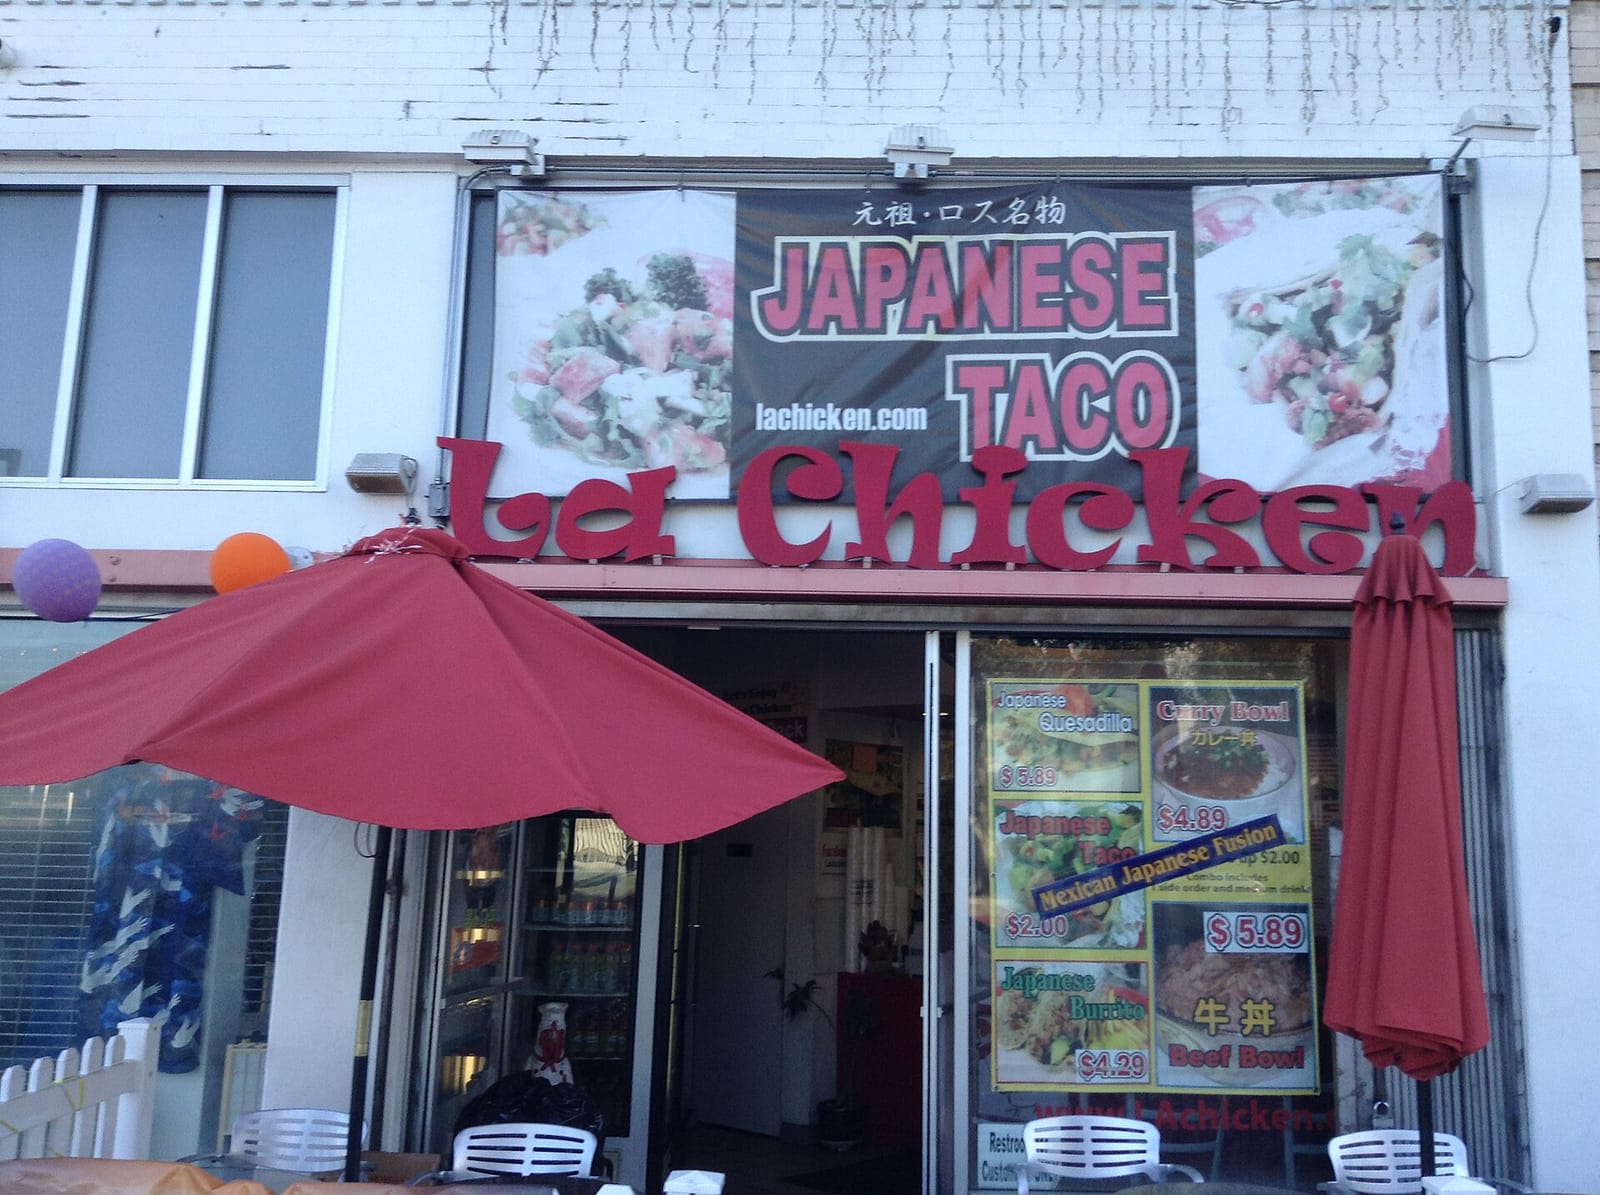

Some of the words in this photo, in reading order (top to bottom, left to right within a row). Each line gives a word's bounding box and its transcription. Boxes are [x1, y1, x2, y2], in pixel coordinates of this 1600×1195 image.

[755, 235, 1174, 338] JAPANESE
[756, 403, 927, 431] lachicken.com
[950, 355, 1177, 457] TACO
[436, 437, 676, 562] La
[737, 440, 1476, 577] Chicken
[997, 691, 1066, 711] Japanese
[1157, 701, 1226, 726] Curry
[1231, 700, 1290, 723] Bowl
[1039, 712, 1132, 733] Quesadilla
[999, 811, 1112, 840] Japanese
[1157, 804, 1228, 832] $4.89
[1078, 840, 1138, 865] Taco
[1261, 851, 1300, 865] $2.00
[1039, 874, 1117, 911] Mexican
[1121, 845, 1210, 885] Japanese
[1213, 824, 1277, 857] Fusion
[1183, 884, 1211, 892] order
[1214, 885, 1233, 893] and
[1006, 912, 1068, 938] $2.00
[1001, 967, 1096, 993] Japanese
[1070, 996, 1145, 1021] Burrito
[1079, 1051, 1147, 1080] $4.29
[1168, 1043, 1232, 1069] Beef
[1239, 1044, 1305, 1069] Bowl
[989, 1132, 1025, 1153] Restroo
